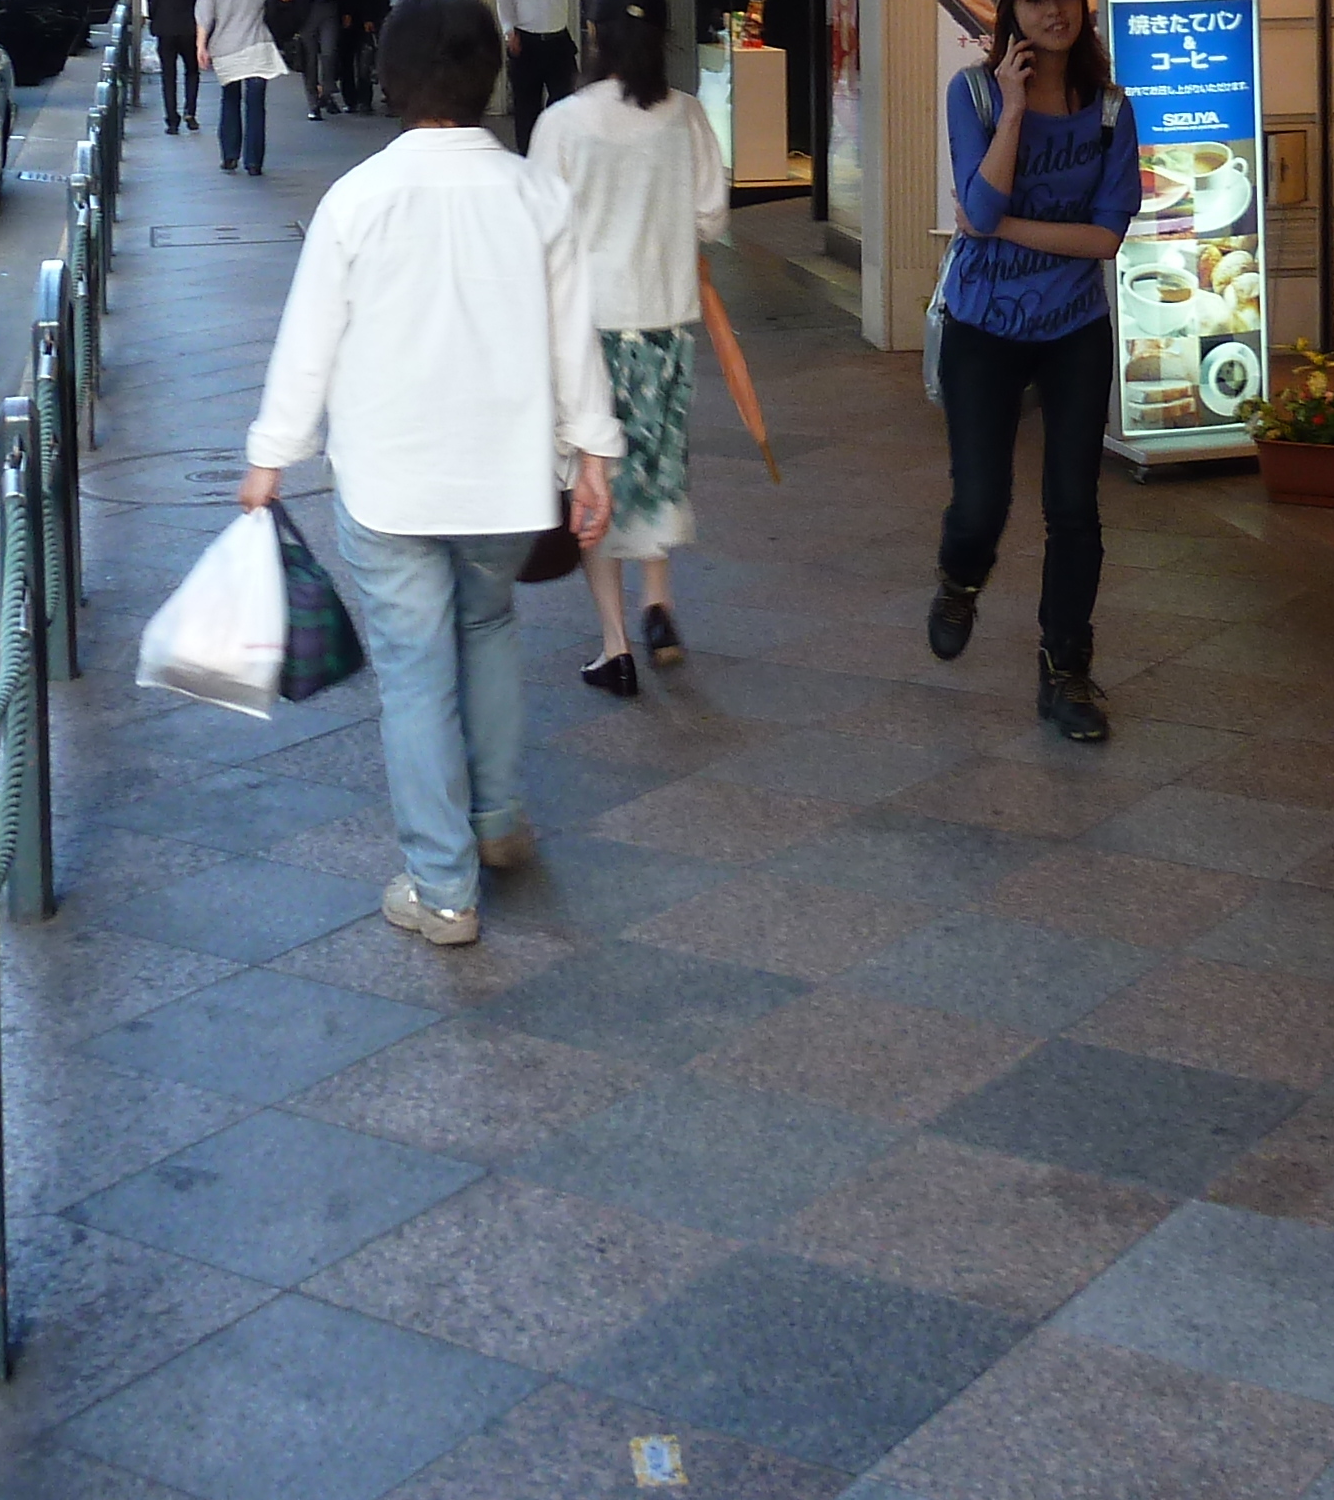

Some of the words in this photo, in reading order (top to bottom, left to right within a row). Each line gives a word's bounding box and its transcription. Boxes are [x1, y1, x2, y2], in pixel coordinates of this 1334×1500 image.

[1128, 11, 1243, 35] 焼きたてパン
[1182, 35, 1197, 50] &
[1151, 51, 1228, 71] コーヒー
[1162, 112, 1220, 126] SIZUYA
